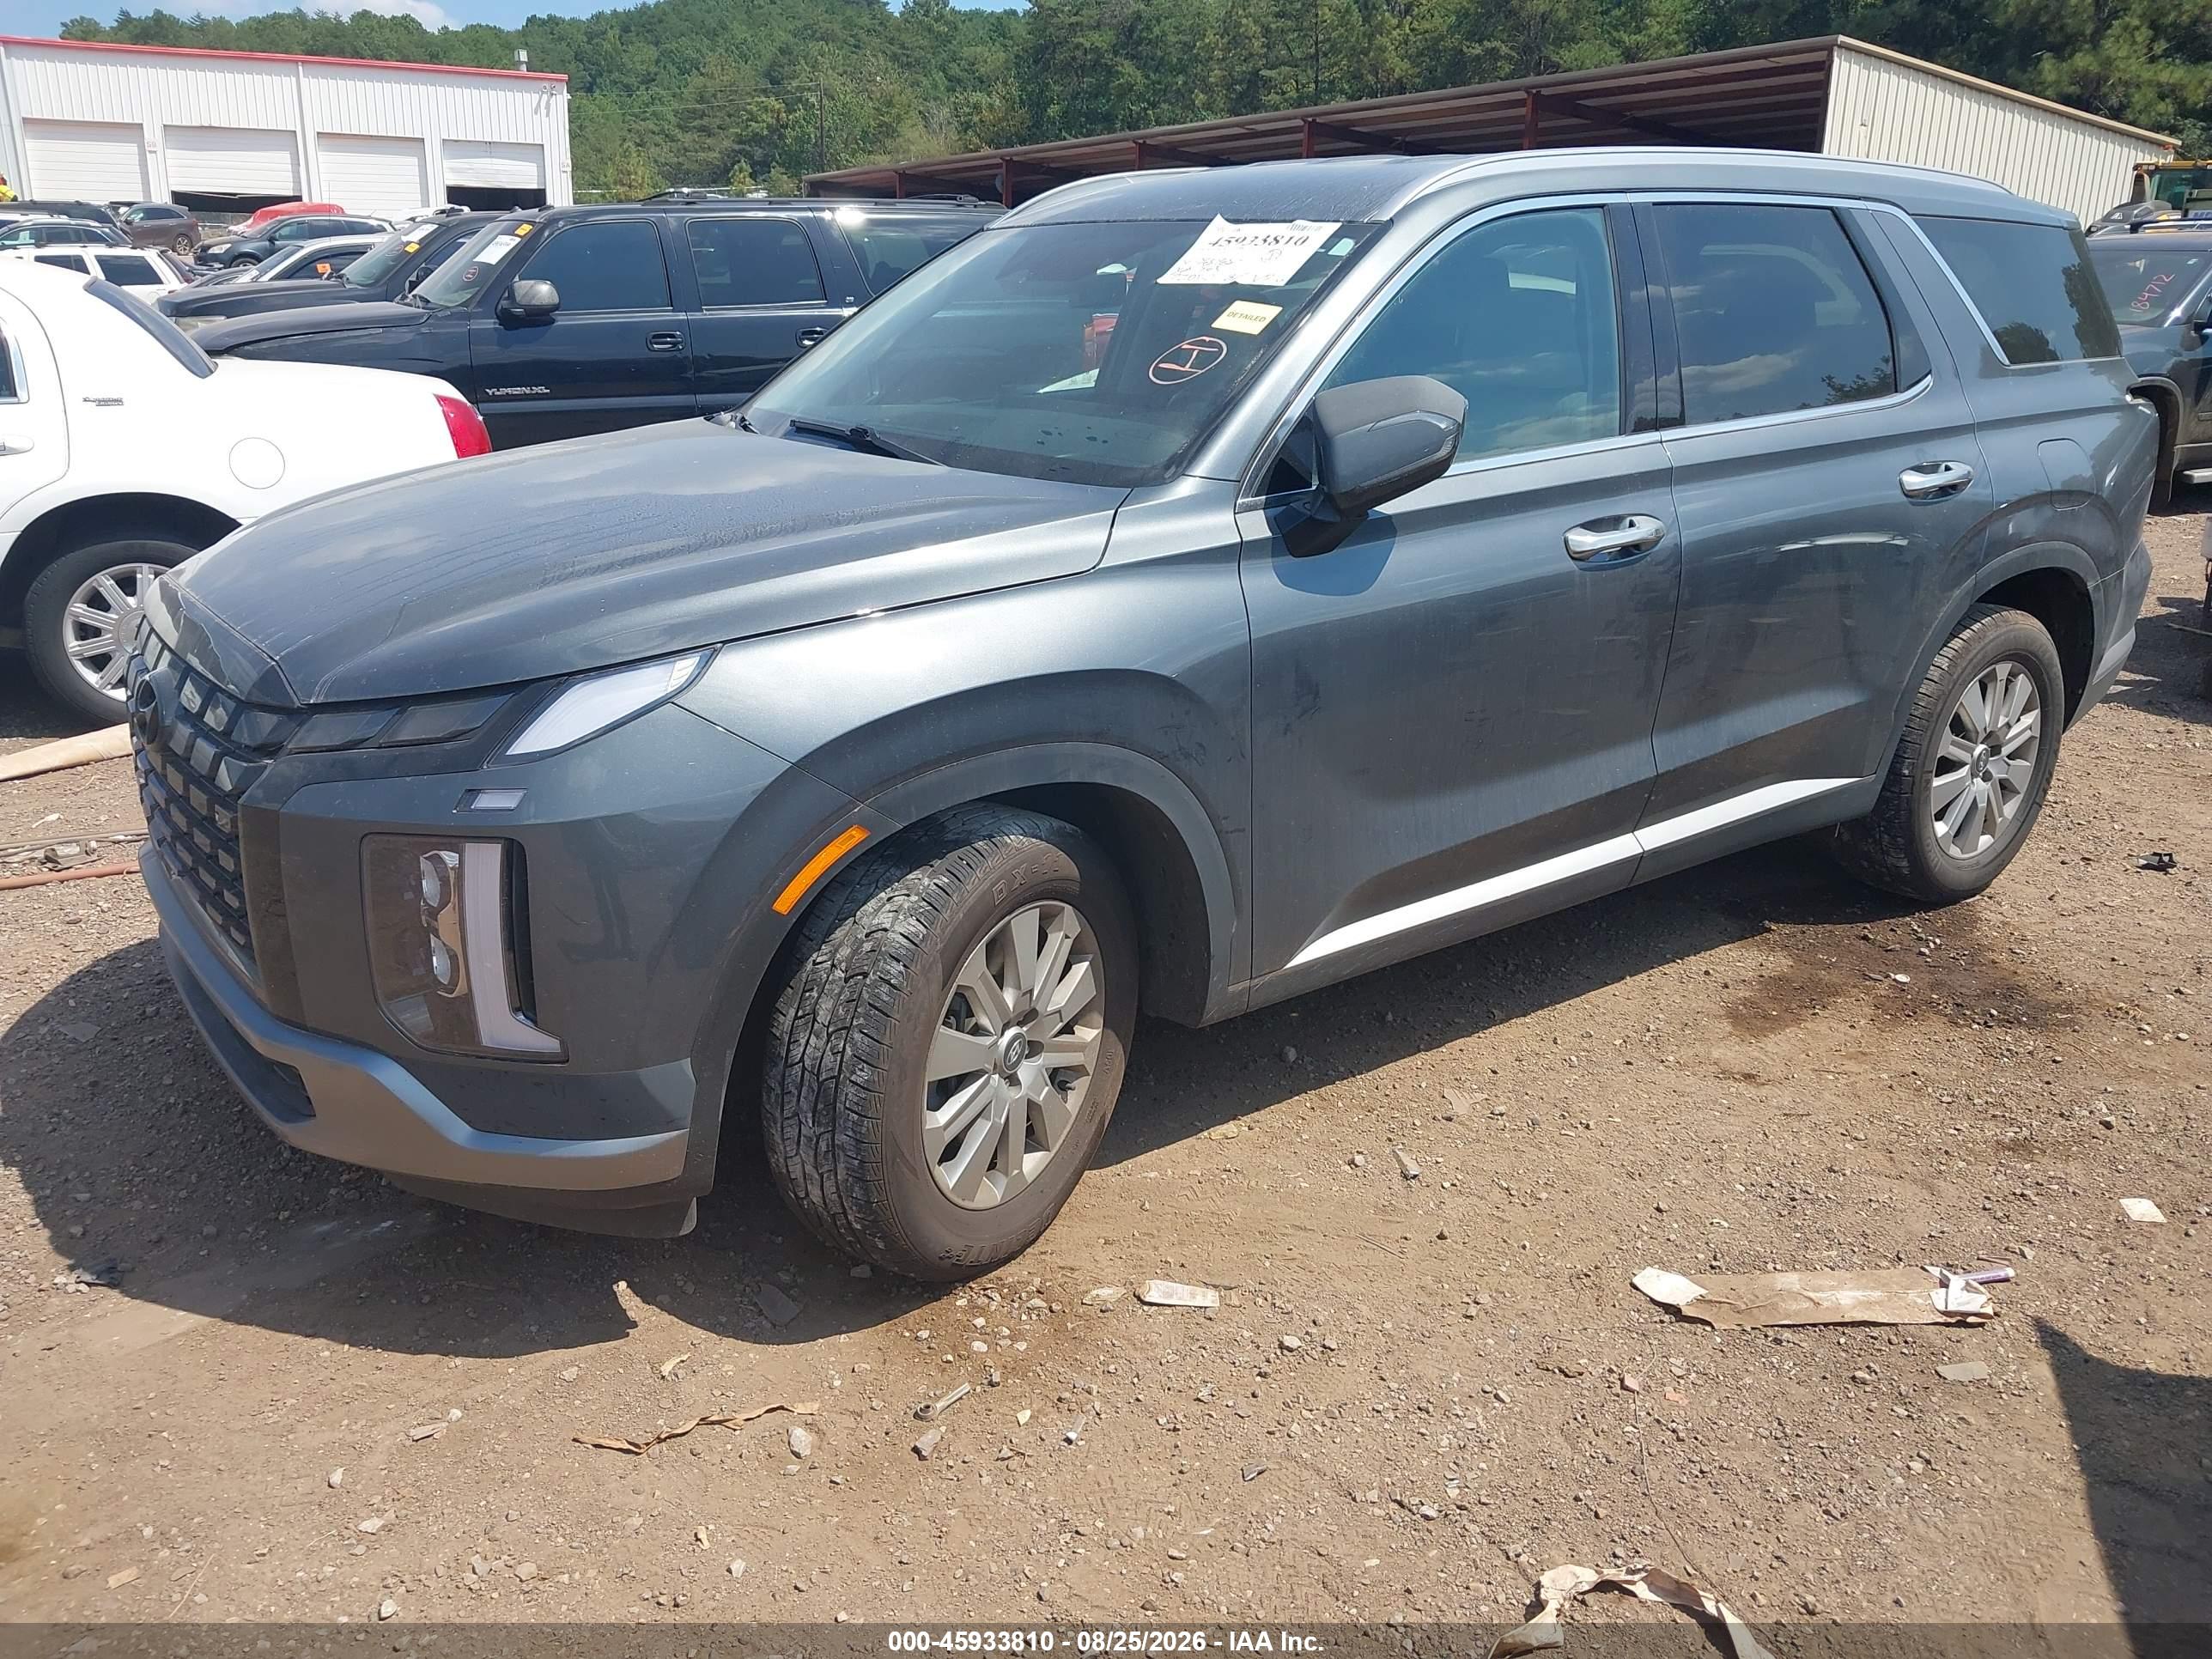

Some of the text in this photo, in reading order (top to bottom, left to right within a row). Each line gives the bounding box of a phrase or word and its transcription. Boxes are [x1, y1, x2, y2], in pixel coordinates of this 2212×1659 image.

[1209, 234, 1310, 247] 45933810
[2130, 274, 2175, 313] 184712
[1226, 311, 1267, 323] DETAILED
